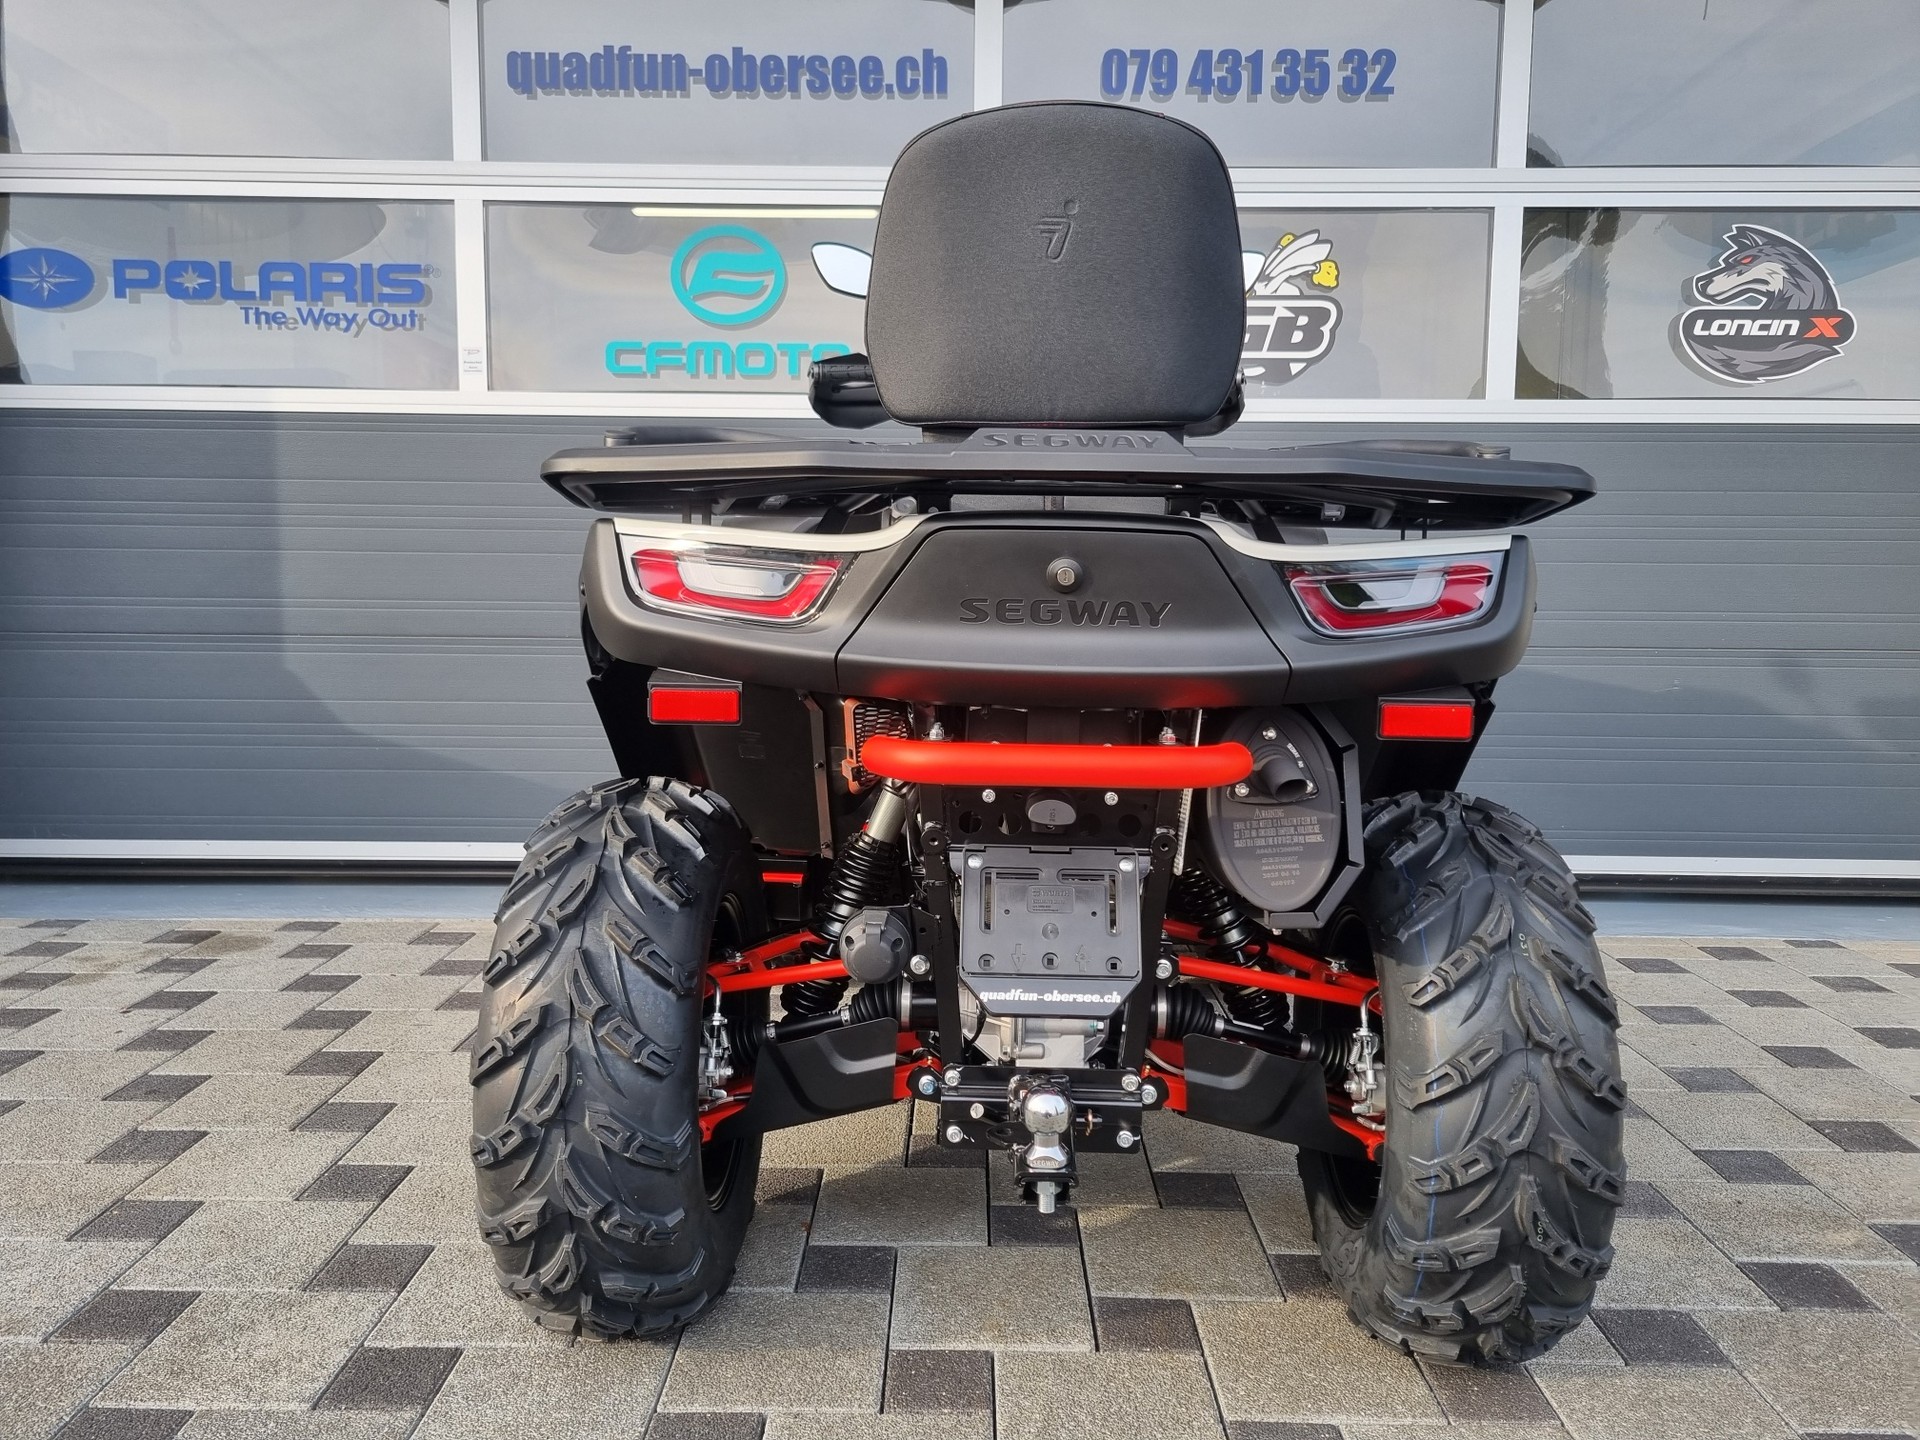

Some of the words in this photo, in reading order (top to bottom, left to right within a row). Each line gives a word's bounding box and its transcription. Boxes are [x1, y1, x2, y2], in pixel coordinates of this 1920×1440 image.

[506, 45, 948, 96] quadfun-obersee.ch
[1102, 48, 1178, 96] 079
[1187, 48, 1263, 96] 431
[1275, 48, 1330, 96] 35
[1342, 48, 1397, 96] 32
[113, 259, 425, 303] POLARIS
[240, 306, 287, 326] The
[296, 307, 358, 333] Way
[368, 308, 421, 328] Out
[1693, 319, 1800, 336] LONCIN
[1803, 317, 1844, 338] X
[983, 433, 1162, 449] SEGWAY
[959, 598, 1172, 628] SEGWAY
[979, 988, 1121, 1004] quadfun-obersee.ch
